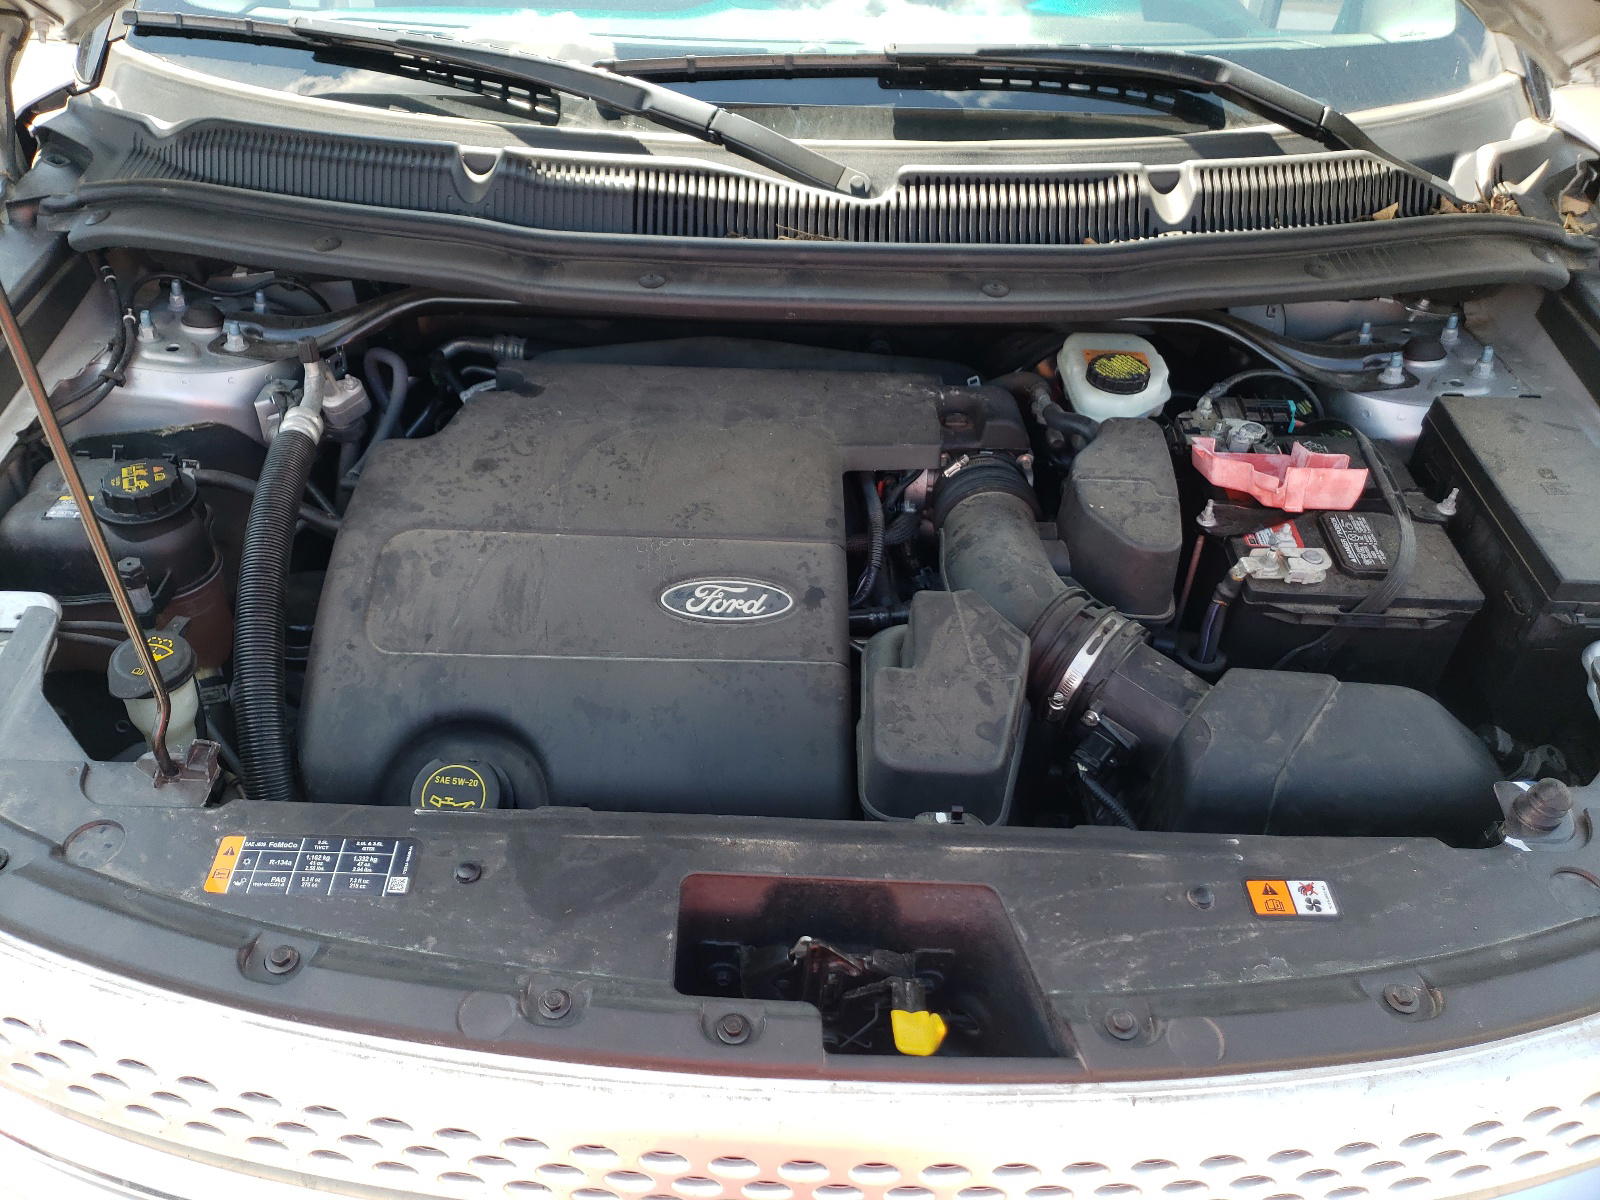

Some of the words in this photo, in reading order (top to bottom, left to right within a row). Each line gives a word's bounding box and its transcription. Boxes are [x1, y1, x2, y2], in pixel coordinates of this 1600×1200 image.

[685, 584, 768, 614] Ford
[435, 776, 450, 784] SAE
[452, 777, 478, 786] 5W-20
